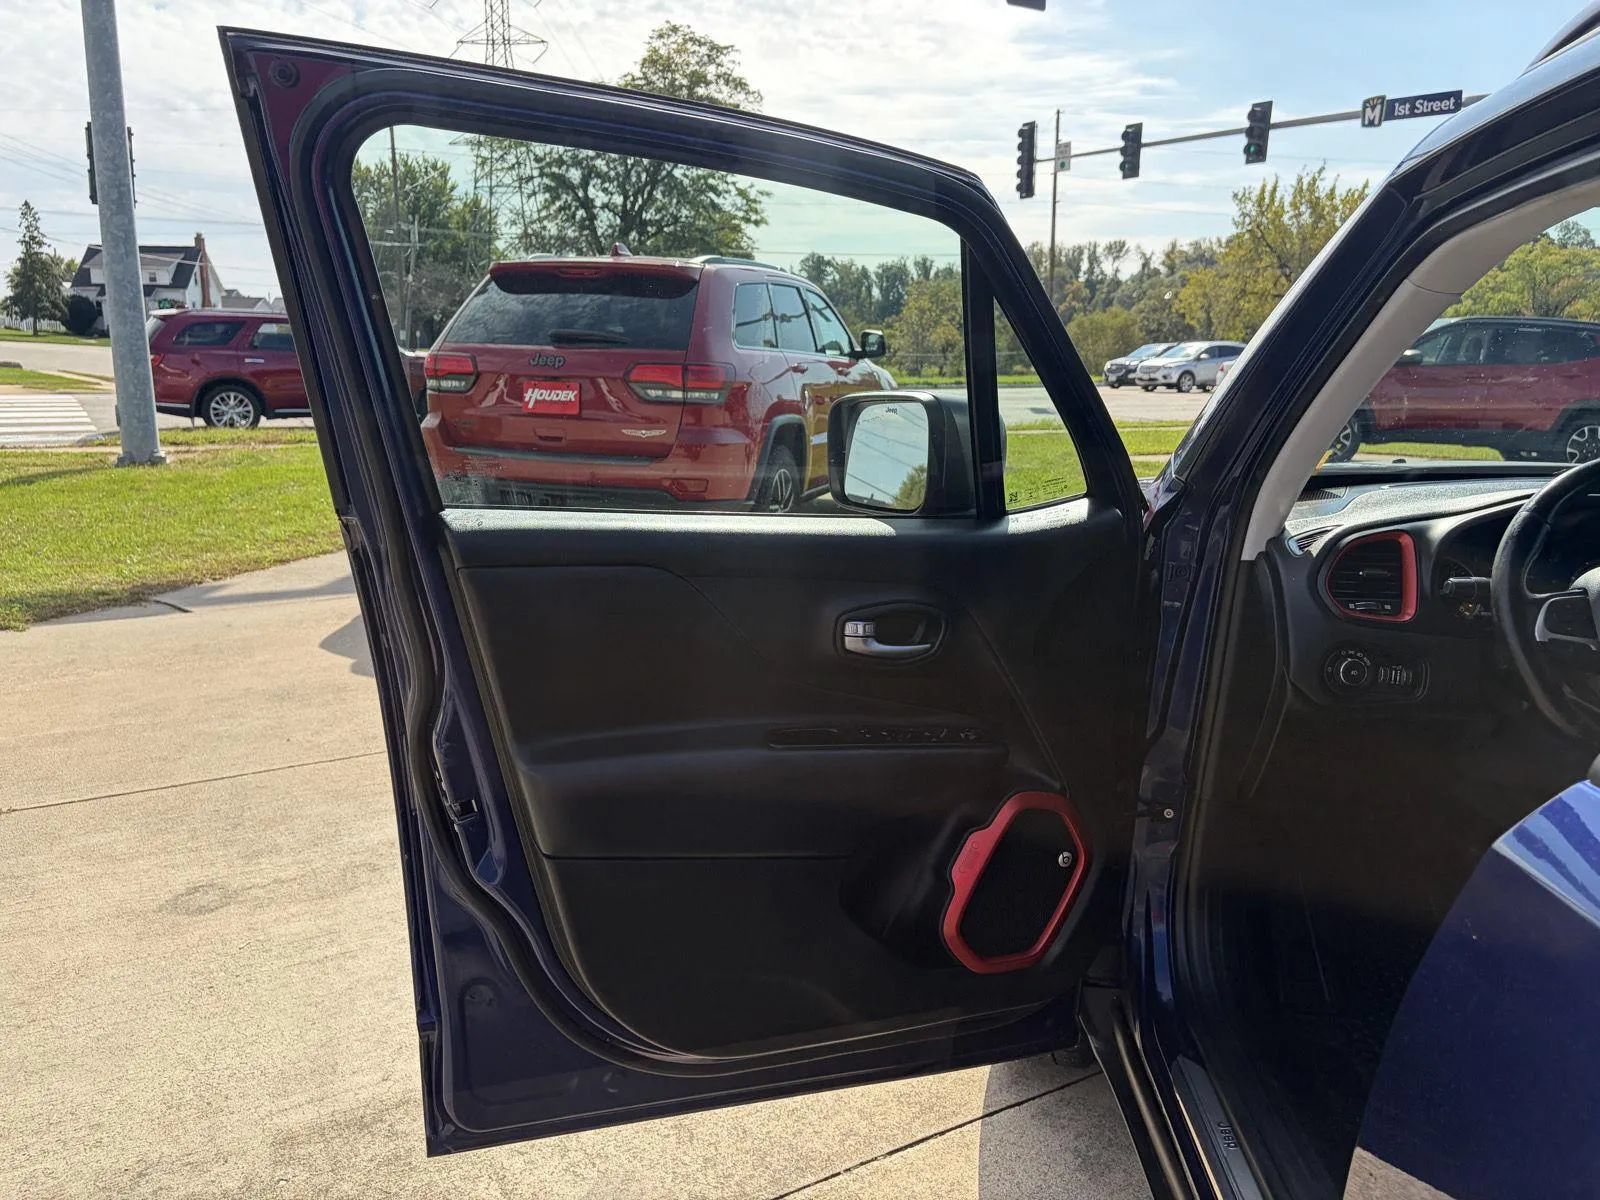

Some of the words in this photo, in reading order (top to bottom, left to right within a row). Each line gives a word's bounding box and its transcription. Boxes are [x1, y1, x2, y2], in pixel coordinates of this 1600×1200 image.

[1394, 103, 1410, 116] 1st
[1414, 97, 1456, 114] Street
[529, 352, 565, 368] Jeep
[524, 388, 577, 409] HOUDEK
[885, 406, 898, 415] Jeep
[1217, 1122, 1239, 1149] Jeep
